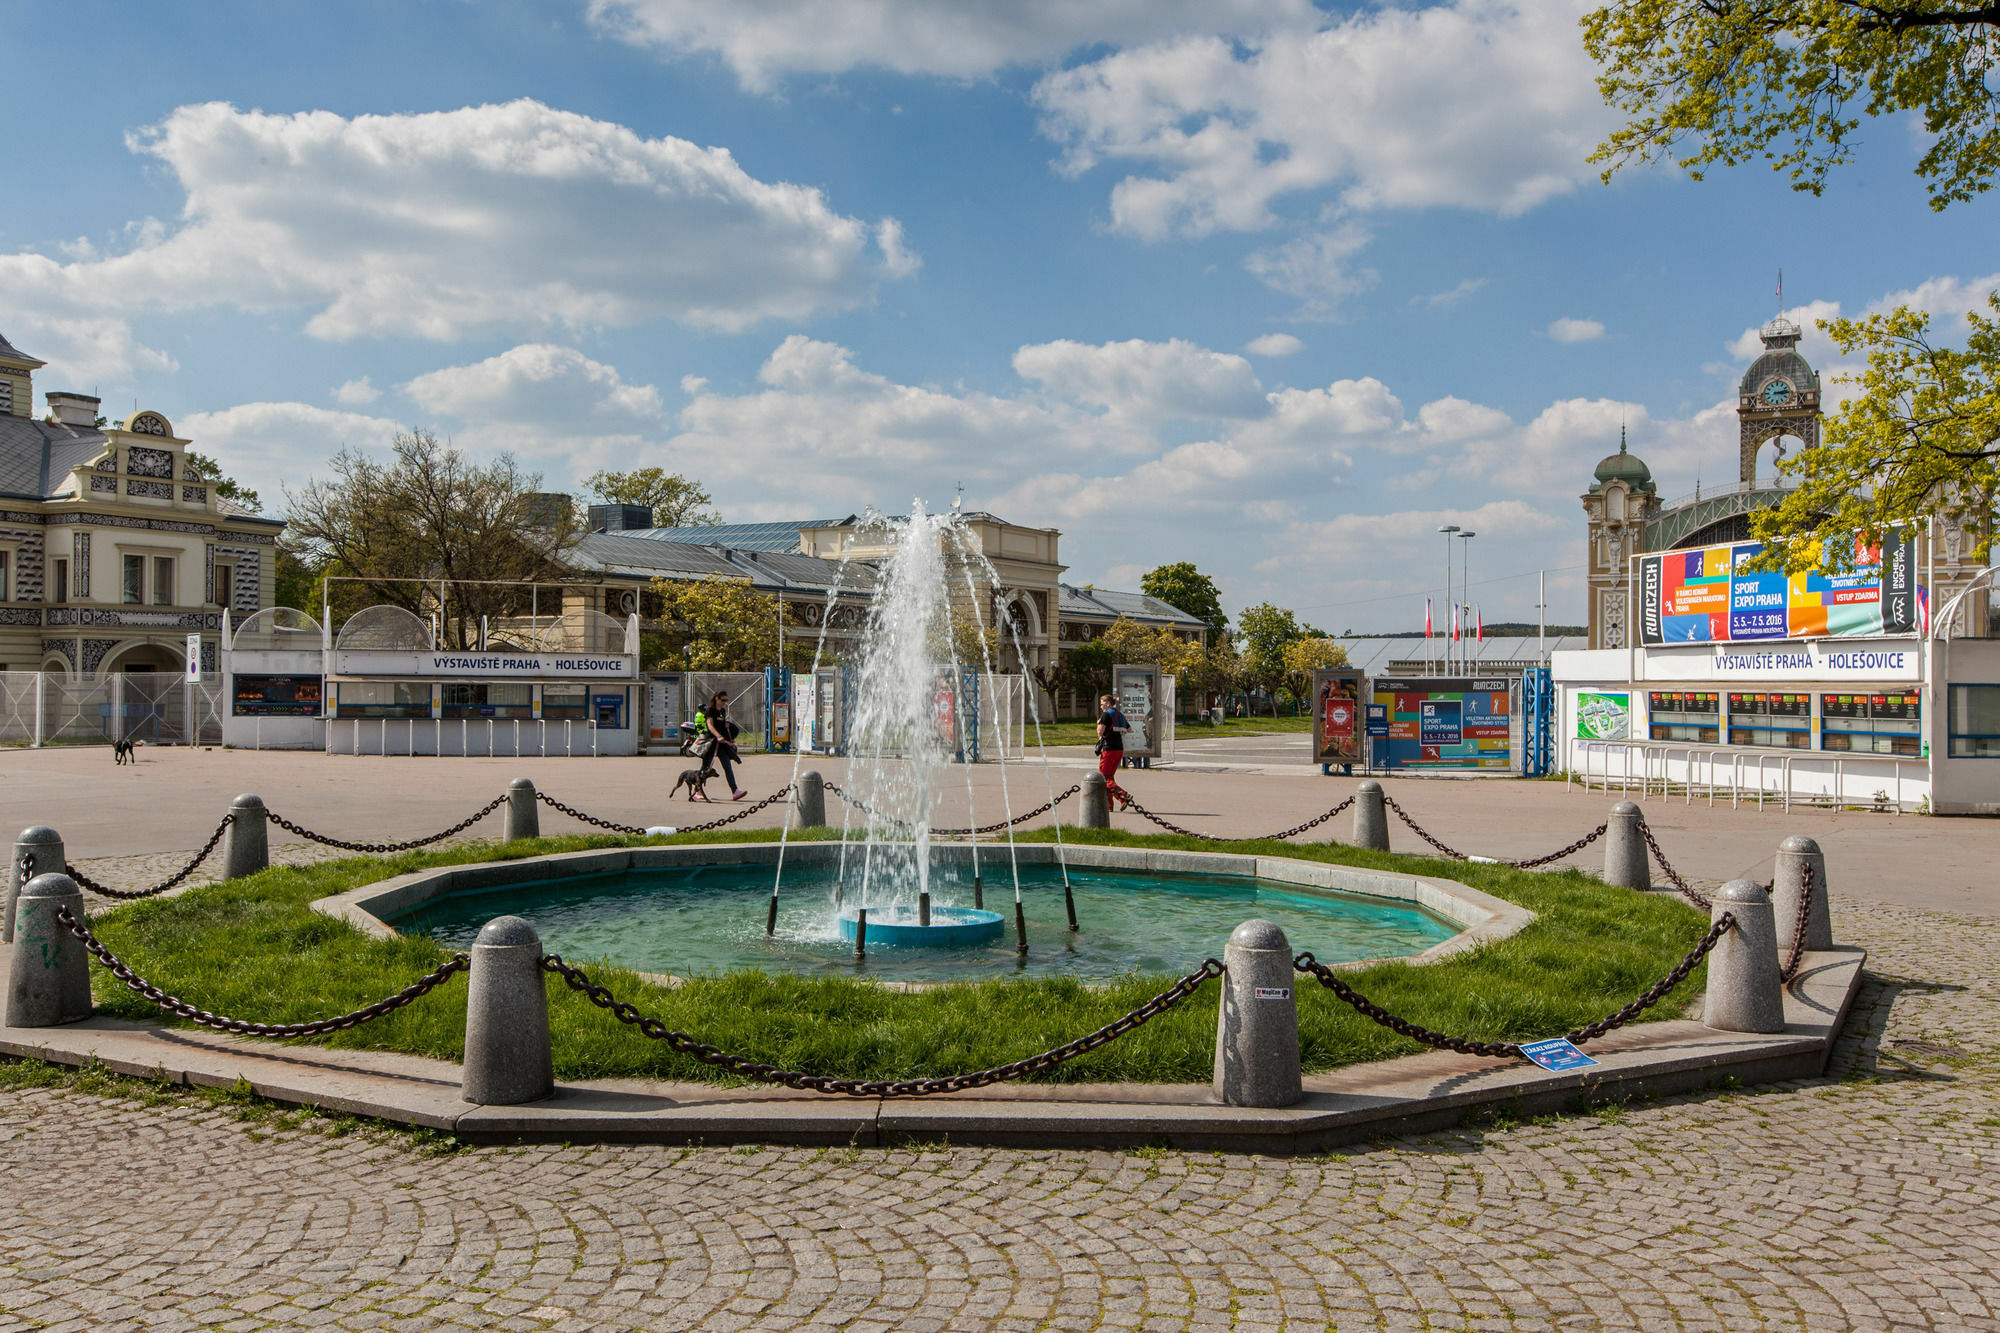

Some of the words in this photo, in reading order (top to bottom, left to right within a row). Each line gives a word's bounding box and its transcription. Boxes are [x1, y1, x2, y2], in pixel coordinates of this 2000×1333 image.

[1735, 582, 1759, 594] SPORT
[1735, 595, 1754, 608] EXPO
[1756, 593, 1783, 606] PRAHA
[1836, 593, 1854, 602] VSTUP
[1855, 592, 1878, 600] ZDARMA
[1766, 614, 1782, 625] 2016
[434, 656, 500, 669] VÝSTAVIŠTĚ
[502, 660, 540, 669] PRAHA
[556, 658, 621, 670] HOLEŠOVICE
[1716, 652, 1773, 669] VÝSTAVIŠTĚ
[1776, 654, 1813, 669] PRAHA
[1829, 651, 1904, 669] HOLEŠOVICE
